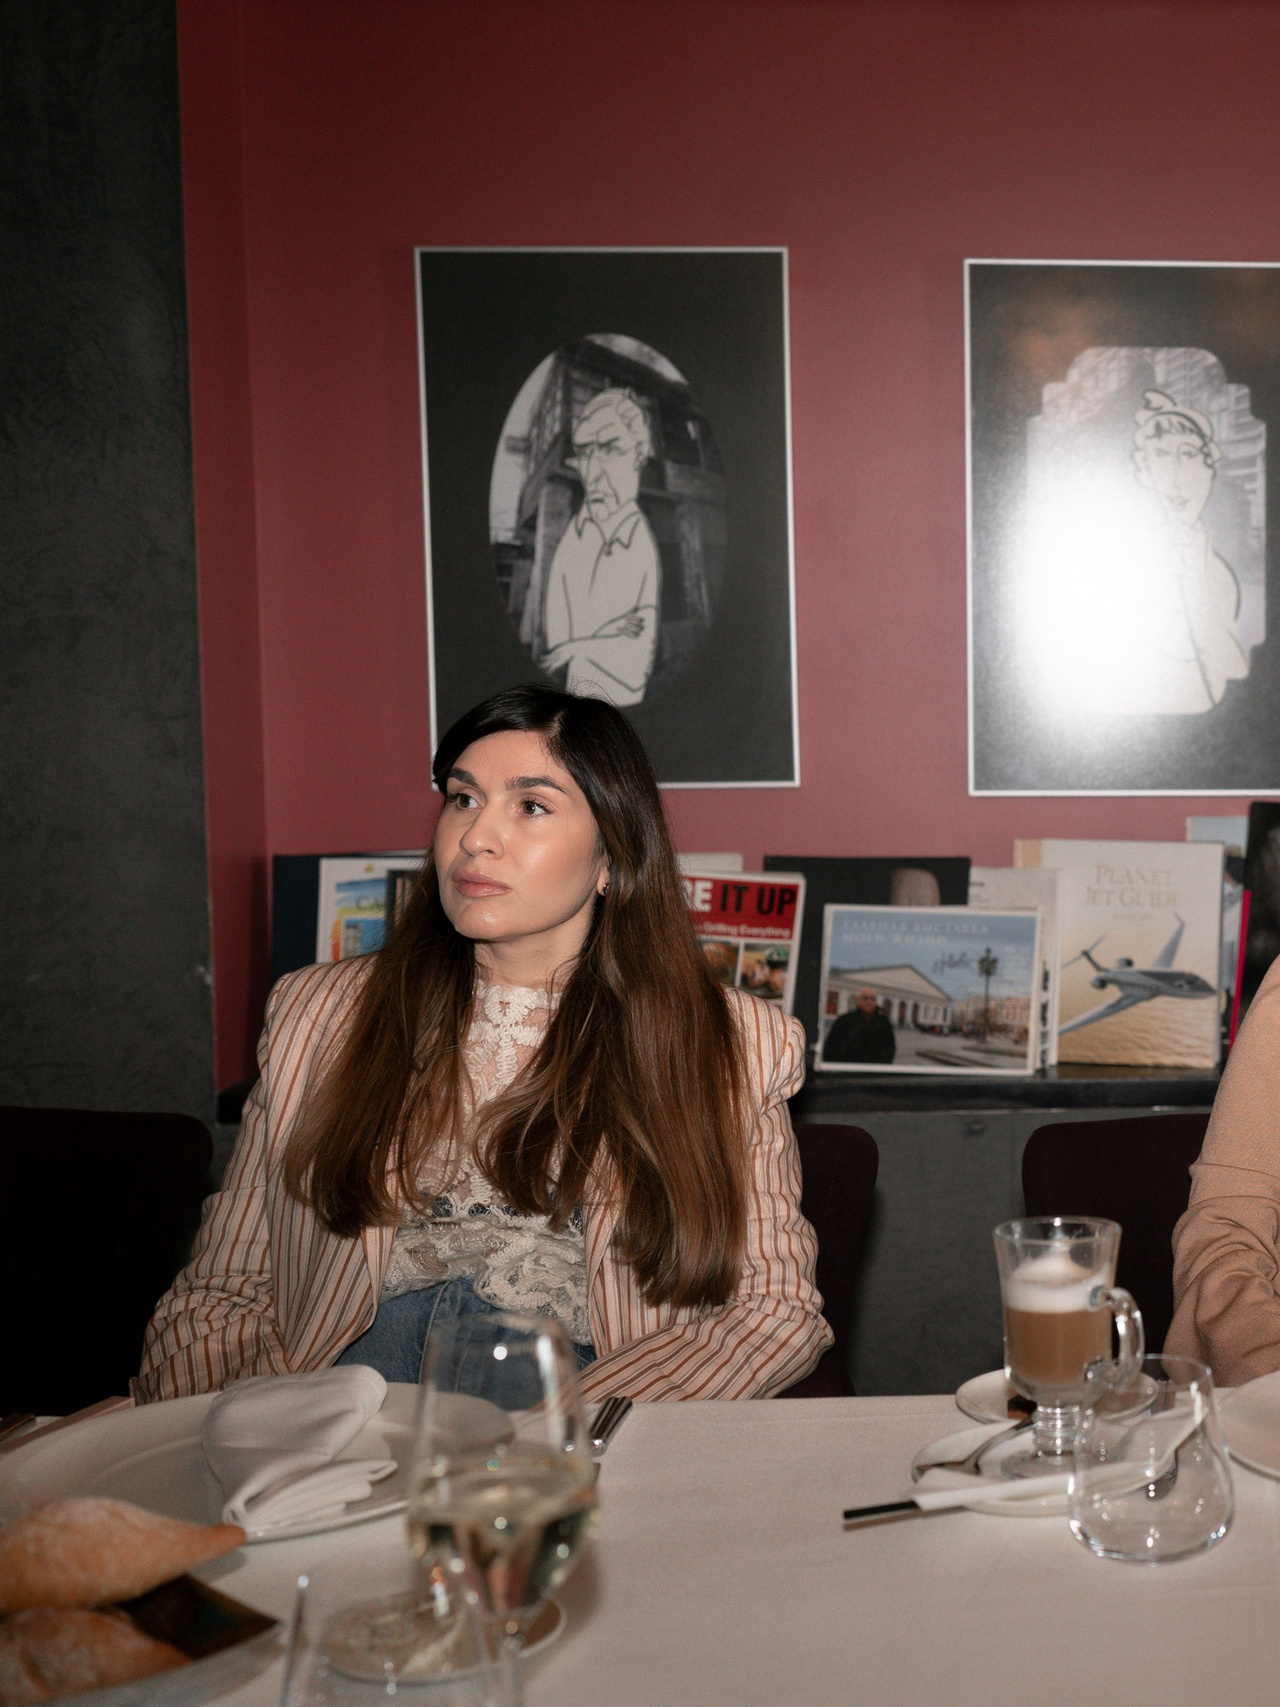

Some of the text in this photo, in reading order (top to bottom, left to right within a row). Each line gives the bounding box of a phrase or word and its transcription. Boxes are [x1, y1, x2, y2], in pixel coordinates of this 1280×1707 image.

[1096, 864, 1173, 886] PLANET
[720, 884, 749, 912] IT
[757, 886, 795, 915] UP
[1085, 886, 1181, 908] JET GUIDE
[739, 923, 791, 939] Everything
